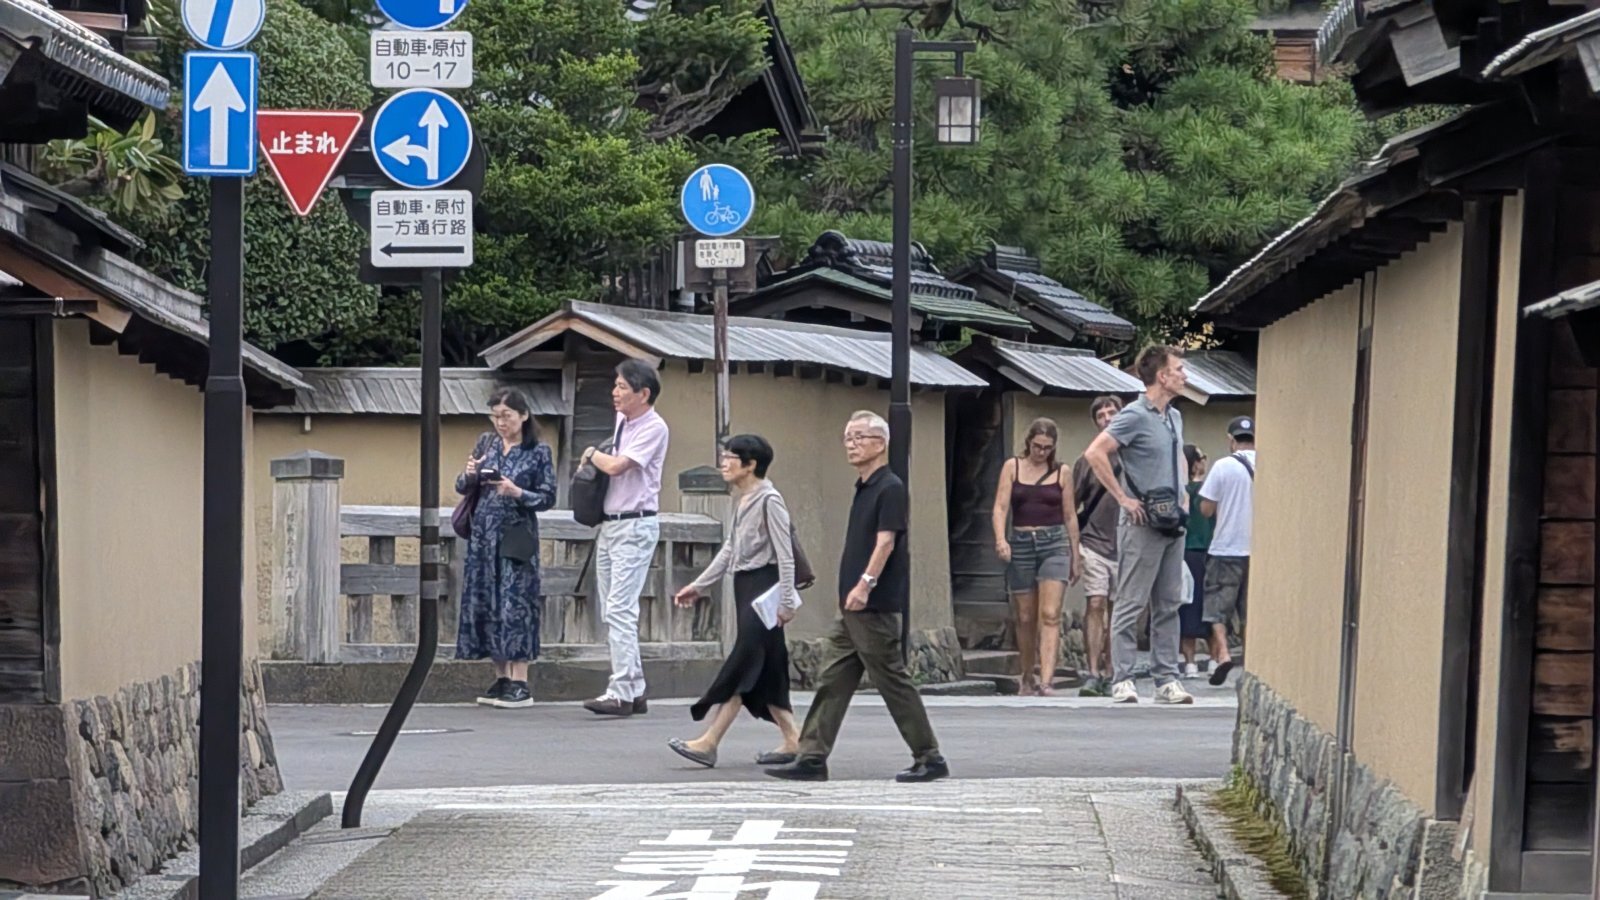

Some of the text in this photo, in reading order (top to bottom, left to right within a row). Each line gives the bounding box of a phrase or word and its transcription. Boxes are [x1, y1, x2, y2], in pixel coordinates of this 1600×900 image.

[376, 38, 467, 58] 自動車・原付
[269, 130, 339, 155] 止まれ
[376, 198, 466, 216] 自動車・原付
[376, 219, 467, 236] 一方通行路
